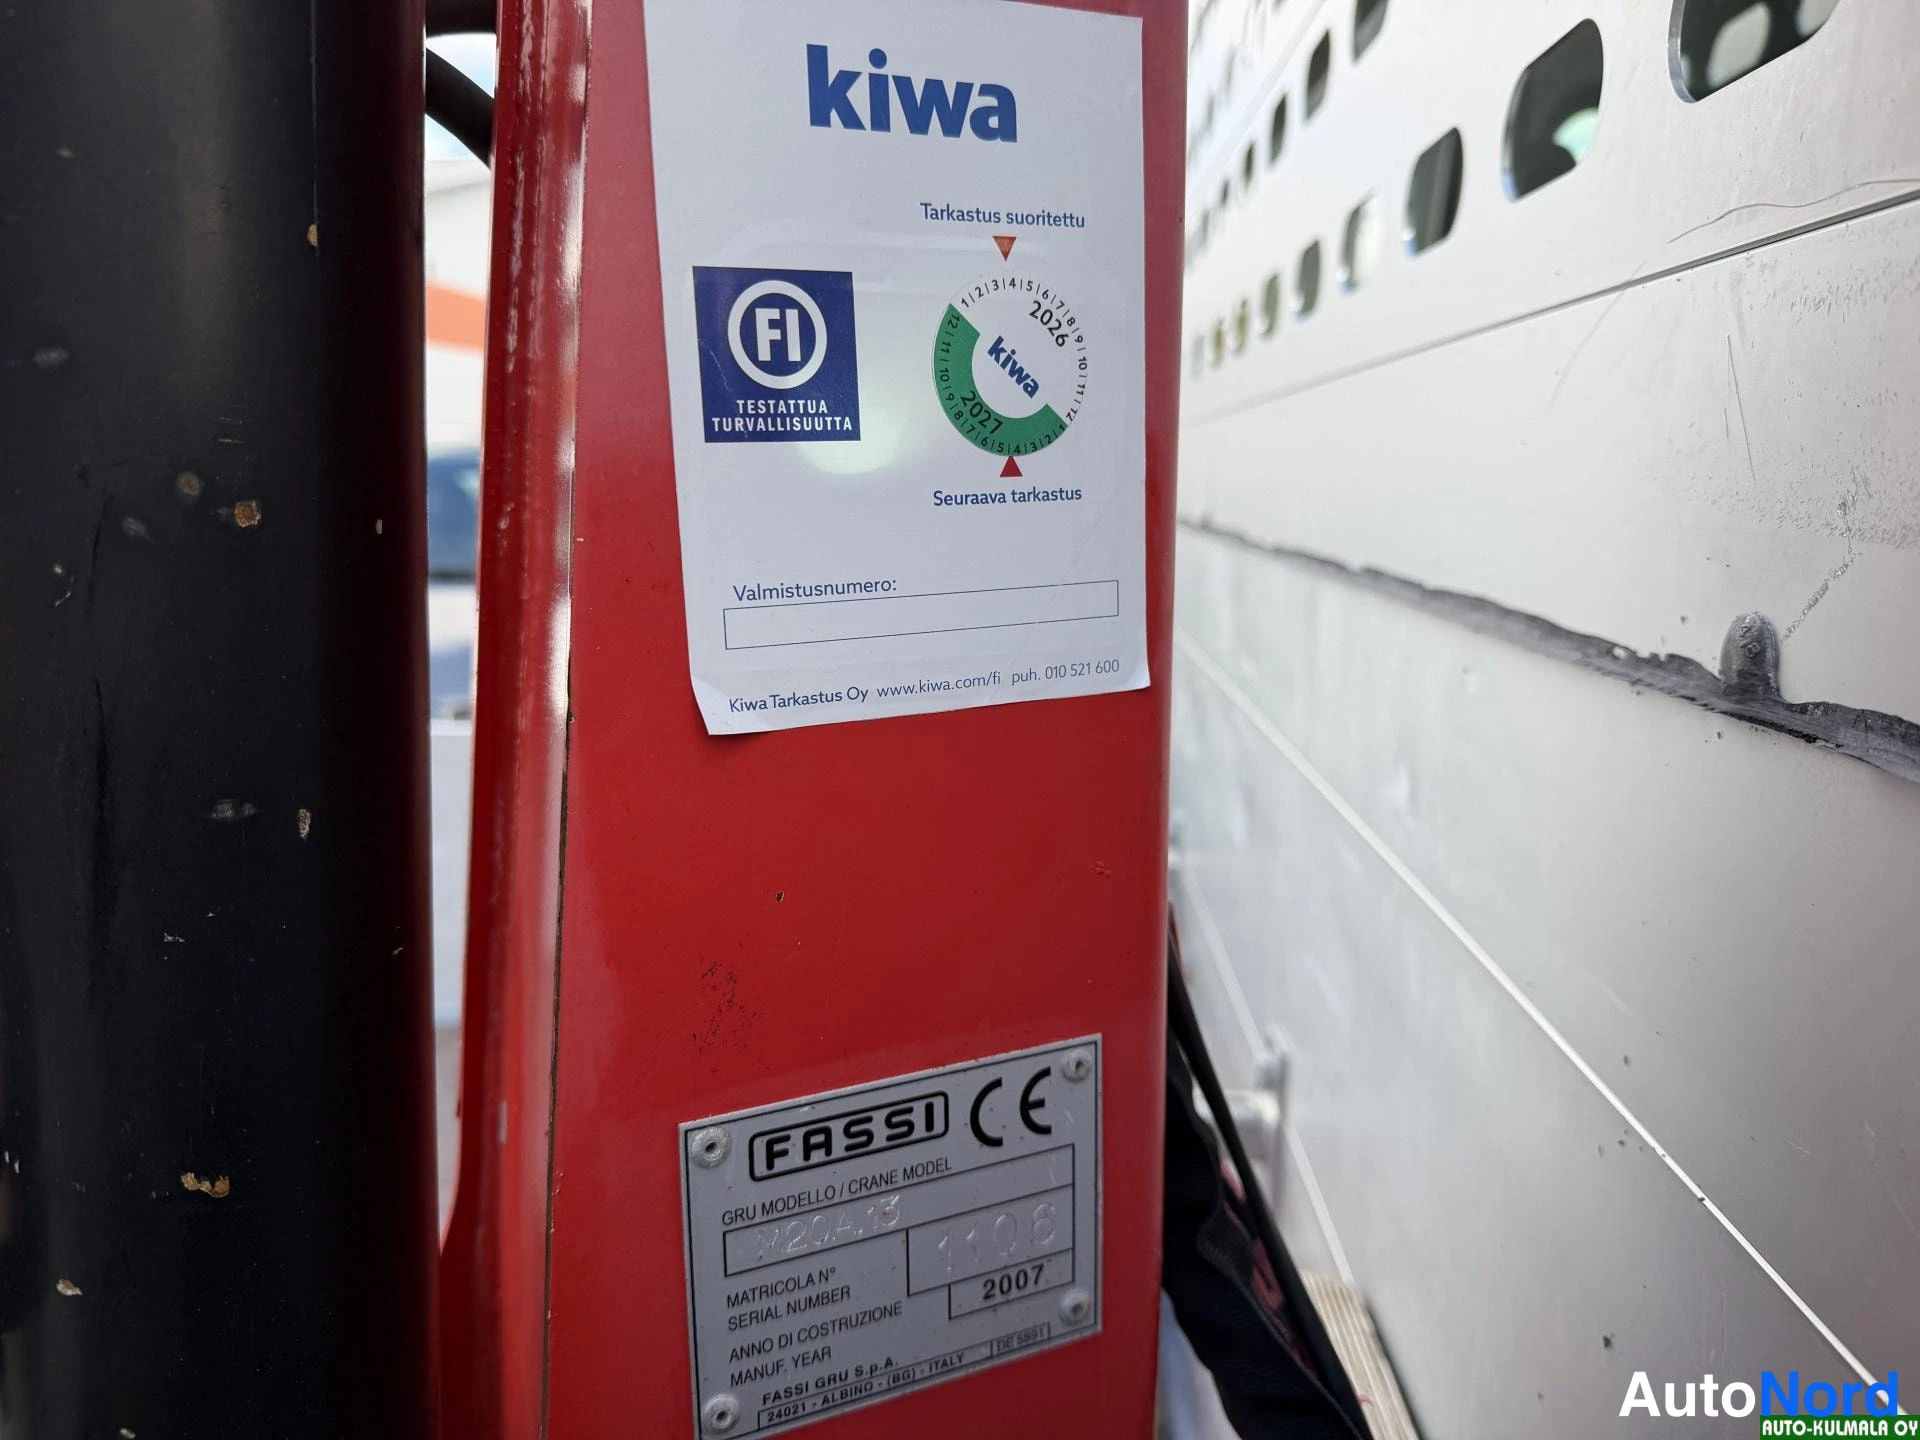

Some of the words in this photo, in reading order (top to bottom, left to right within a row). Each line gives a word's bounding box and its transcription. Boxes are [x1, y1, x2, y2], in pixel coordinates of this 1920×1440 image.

[806, 42, 1018, 143] kiwa
[920, 203, 1001, 224] Tarkastus
[1006, 209, 1085, 228] suoritettu
[755, 308, 801, 361] FI
[1028, 300, 1069, 347] 2026
[987, 335, 1040, 399] kiwa
[712, 416, 852, 432] TURVALLISUUTTA
[736, 400, 828, 414] TESTATTUA
[960, 390, 1004, 435] 2027
[933, 490, 1007, 506] Seuraava
[1011, 486, 1082, 503] tarkastus
[733, 578, 897, 602] Valmistusnumero:
[729, 698, 768, 713] Kiwa
[768, 688, 843, 708] Tarkastus
[846, 686, 869, 704] Oy
[876, 671, 1001, 698] www.kiwa.com/fi
[1011, 669, 1042, 686] puh.
[1045, 665, 1067, 680] 010
[1070, 663, 1092, 678] 521
[1095, 659, 1120, 674] 600
[764, 1101, 936, 1172] FASSI
[721, 1209, 757, 1226] GRU
[761, 1184, 836, 1216] MODELLO
[848, 1169, 898, 1194] CRANE
[903, 1156, 952, 1181] MODEL
[727, 1273, 815, 1308] MATRICOLA
[982, 1263, 1045, 1300] 2007
[728, 1306, 783, 1331] SERIAL
[787, 1285, 851, 1315] NUMBER
[729, 1337, 774, 1363] ANNO
[778, 1332, 793, 1348] DI
[797, 1301, 902, 1342] COSTRUZIONE
[730, 1358, 787, 1388] MANUF.
[792, 1346, 832, 1368] YEAR
[762, 1380, 809, 1405] FASSI
[815, 1369, 849, 1389] GRU
[767, 1399, 806, 1422] 24021
[820, 1380, 873, 1406] ALBINO
[887, 1368, 916, 1389] (BG)
[929, 1351, 965, 1373] ITALY
